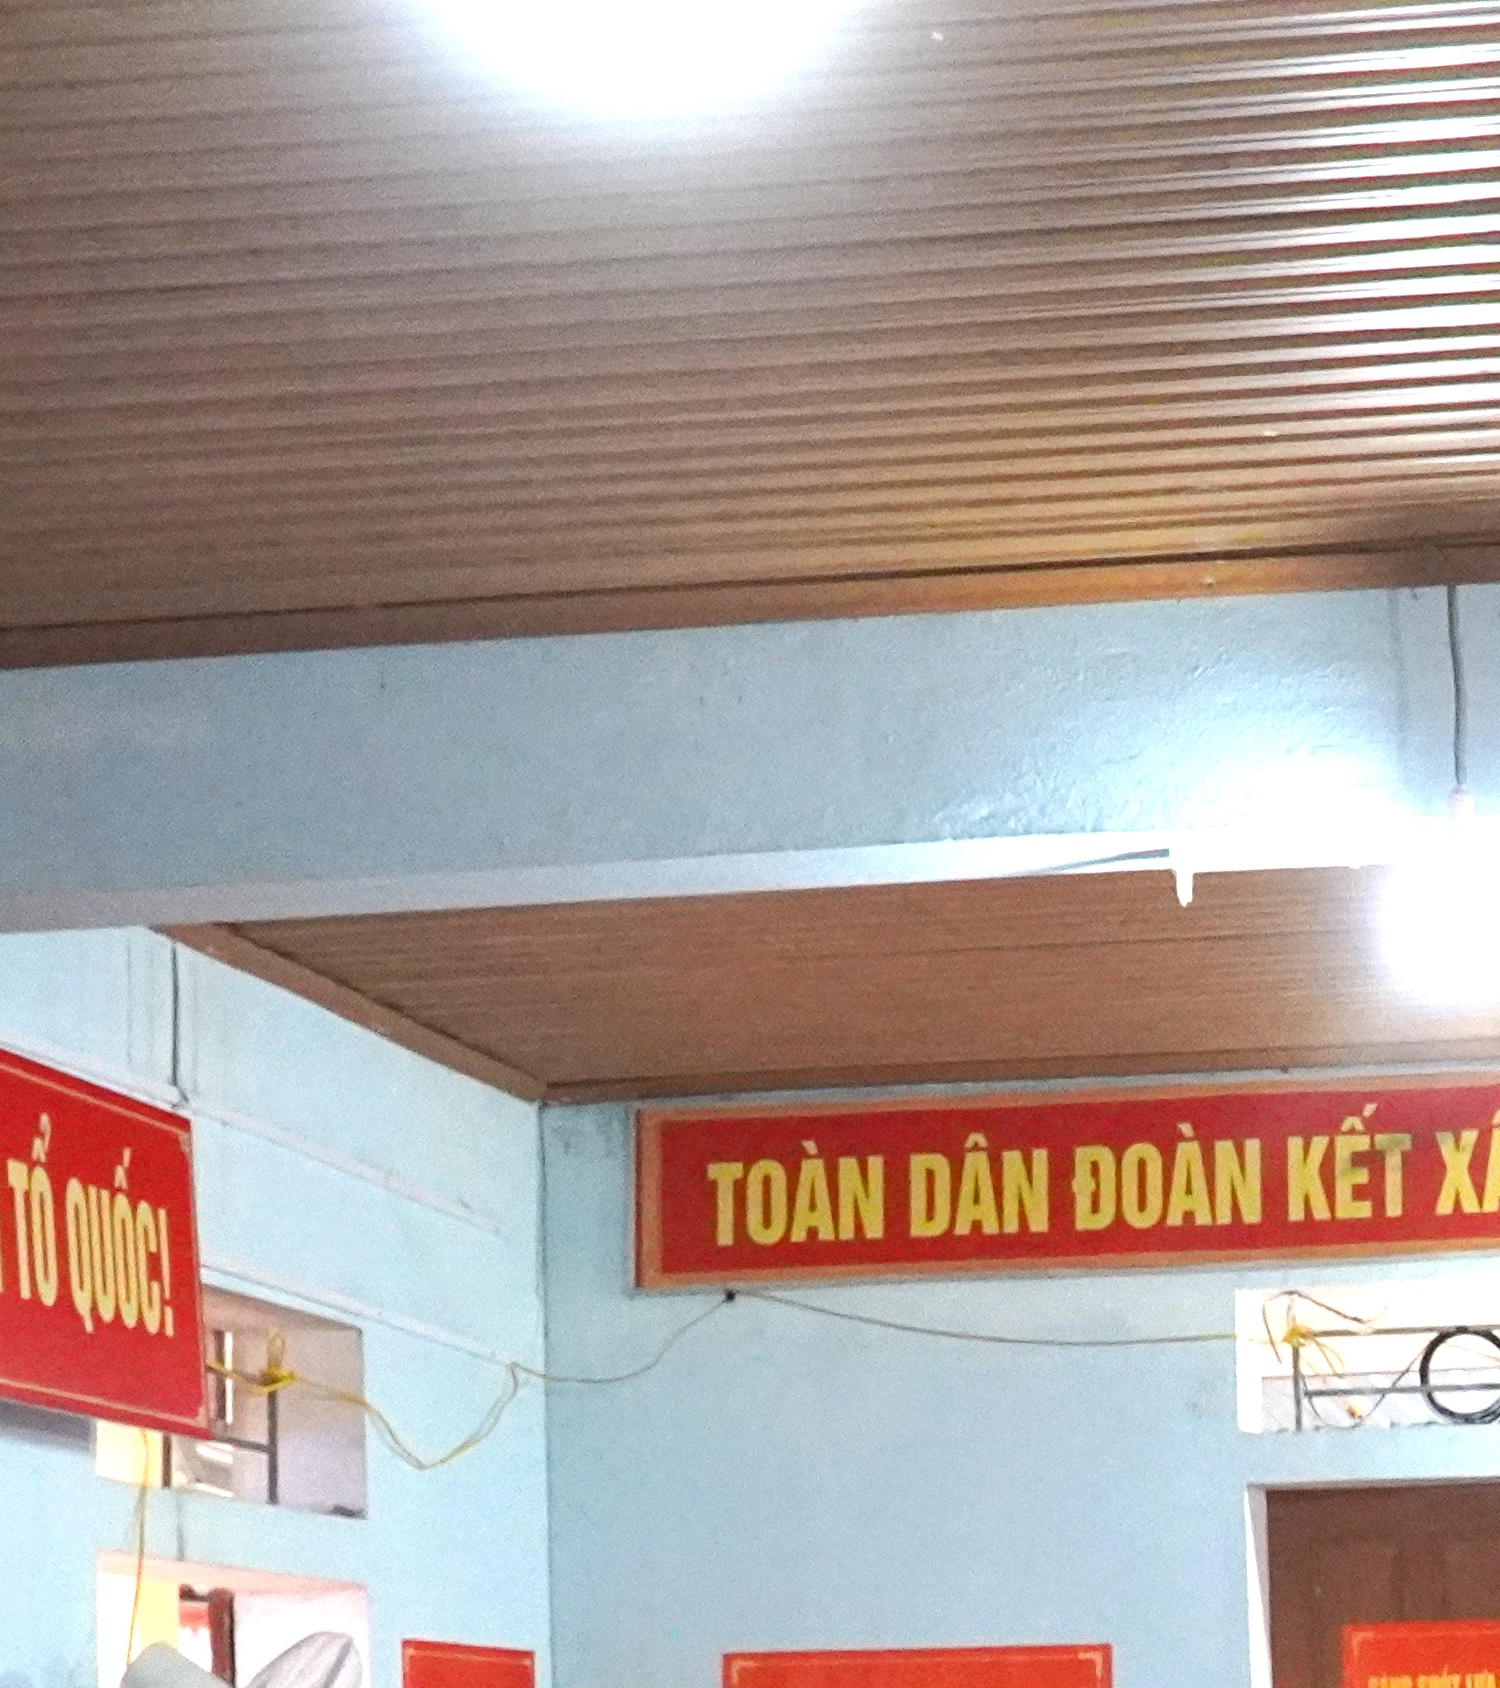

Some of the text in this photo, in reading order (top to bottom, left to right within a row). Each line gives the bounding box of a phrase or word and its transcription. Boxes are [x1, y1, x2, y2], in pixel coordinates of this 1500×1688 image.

[9, 1112, 59, 1307] TỔ
[65, 1148, 175, 1336] QUỐC!
[708, 1141, 884, 1246] TOÀN
[909, 1132, 1048, 1237] DÂN
[1072, 1122, 1262, 1232] ĐOÀN
[1287, 1102, 1413, 1222] KẾT
